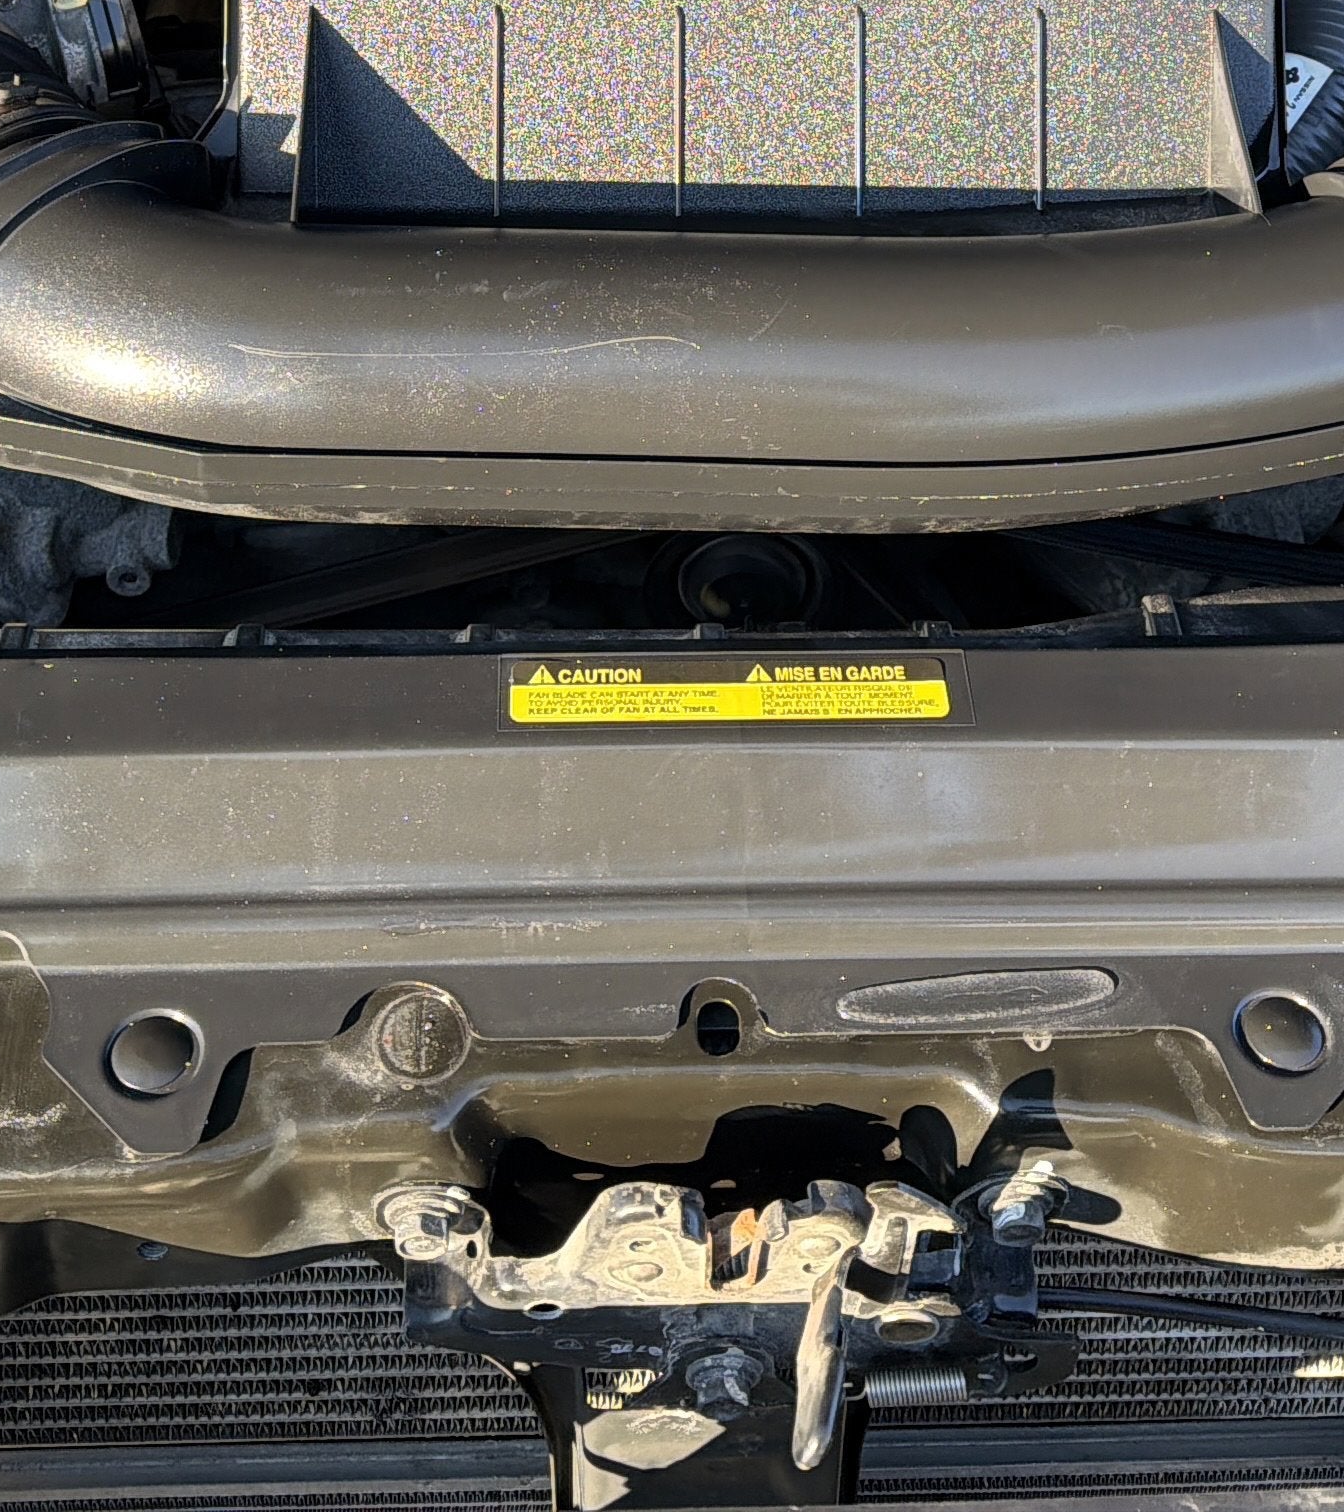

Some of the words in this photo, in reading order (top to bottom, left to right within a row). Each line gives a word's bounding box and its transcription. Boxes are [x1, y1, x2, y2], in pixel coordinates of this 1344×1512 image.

[557, 668, 642, 684] CAUTION
[775, 667, 816, 682] MISE
[819, 667, 843, 681] EN
[846, 666, 906, 681] GARDE
